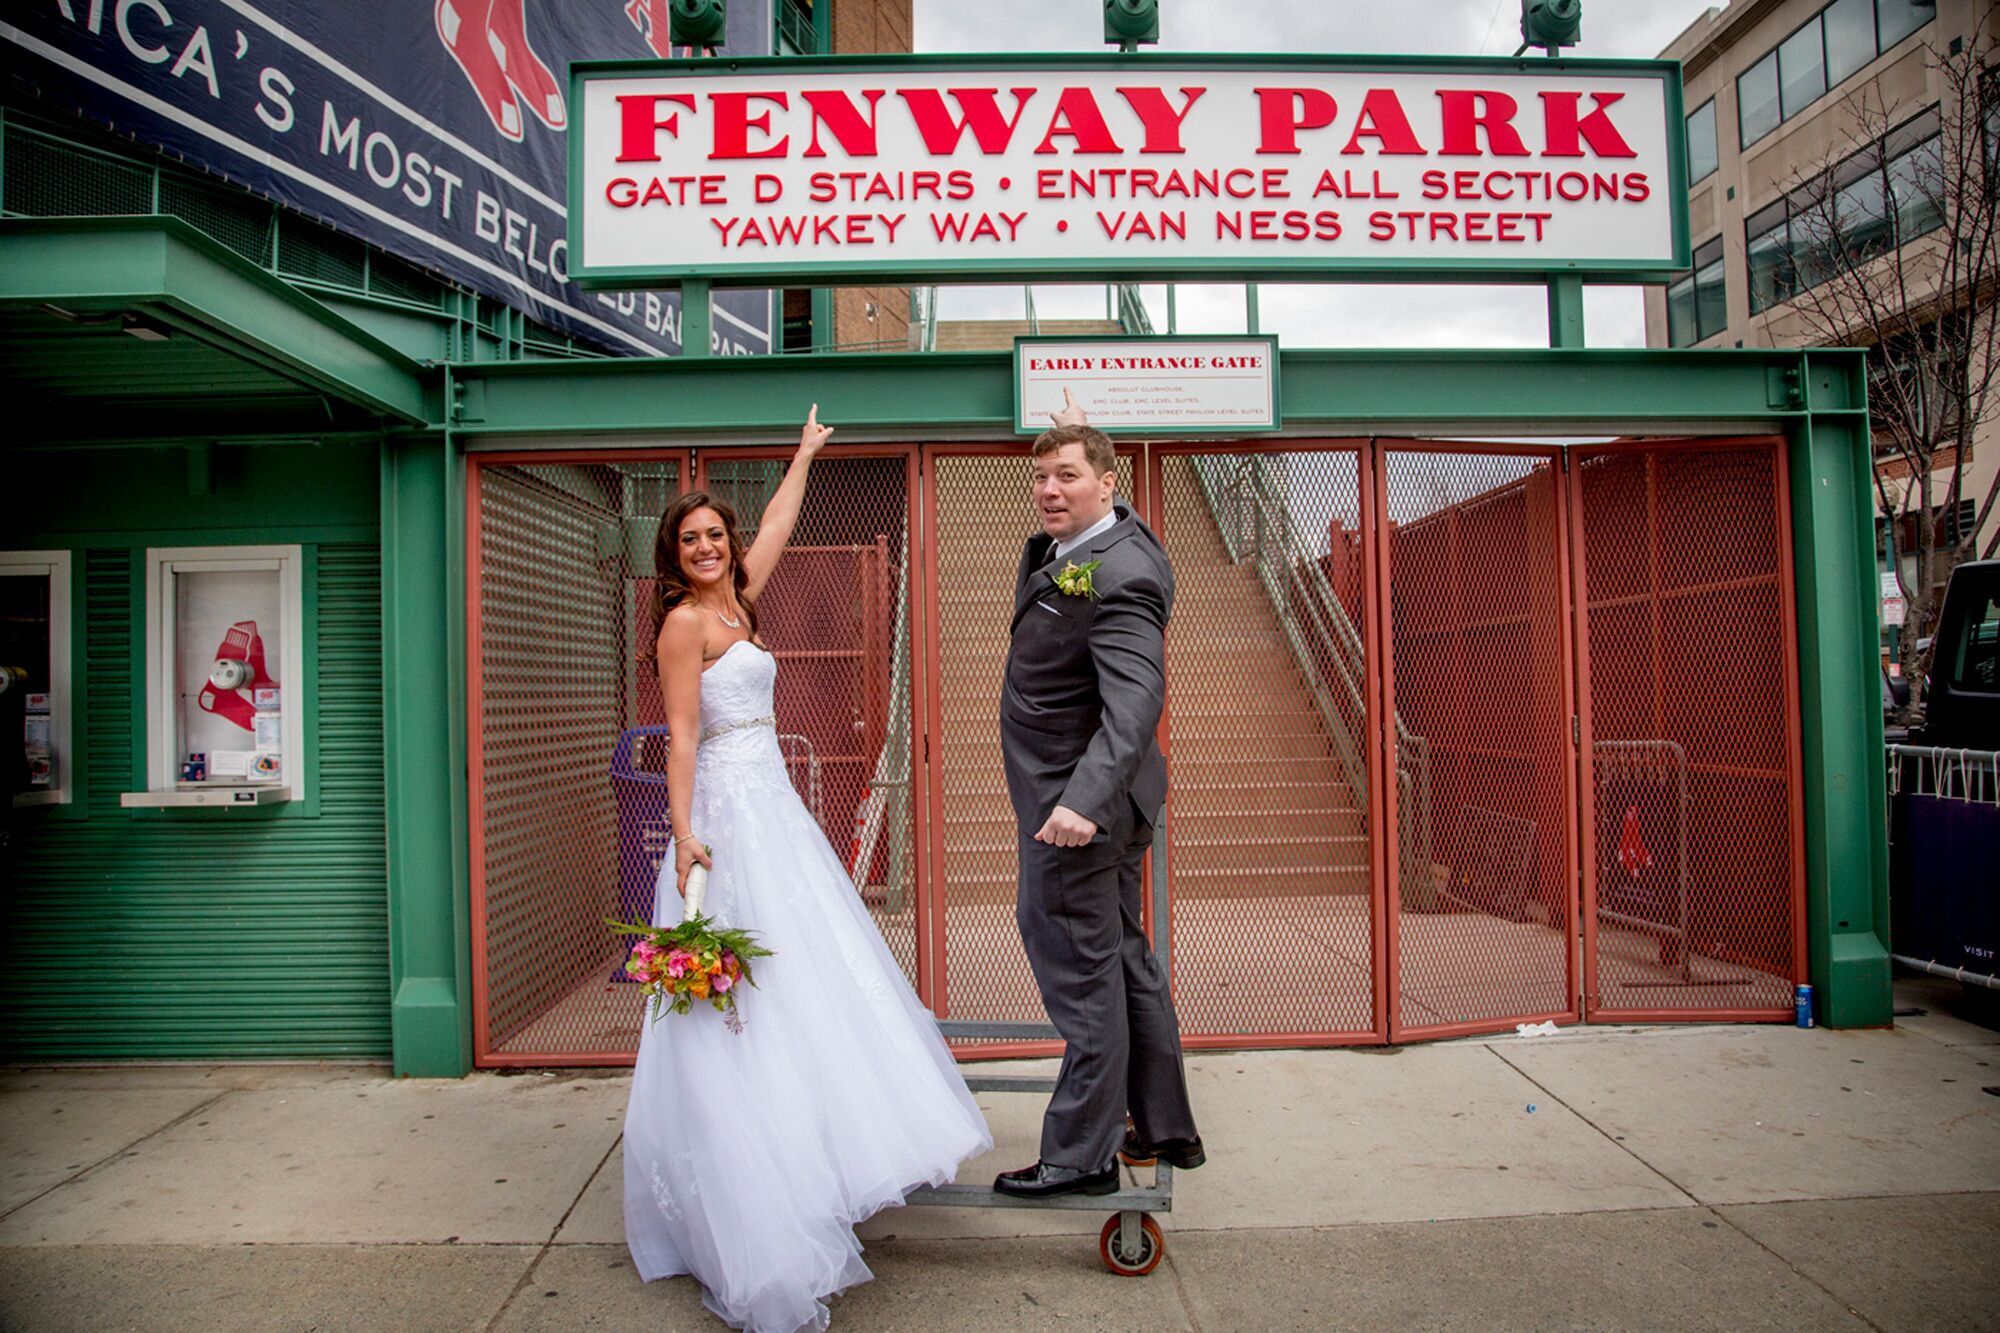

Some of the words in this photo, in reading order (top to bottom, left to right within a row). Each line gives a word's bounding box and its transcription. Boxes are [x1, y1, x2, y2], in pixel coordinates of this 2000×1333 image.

[616, 86, 1207, 162] FENWAY
[1253, 86, 1639, 159] PARK
[319, 100, 462, 220] MOST
[605, 174, 728, 208] GATE
[755, 173, 783, 203] D
[810, 170, 975, 203] STAIRS
[1037, 167, 1291, 199] ENTRANCE
[1312, 168, 1400, 199] ALL
[1421, 169, 1651, 203] SECTIONS
[711, 213, 907, 247] YAWKEY
[930, 211, 1028, 242] WAY
[1096, 210, 1187, 241] VAN
[1215, 209, 1343, 241] NESS
[1368, 210, 1553, 242] STREET
[1030, 358, 1095, 371] EARLY
[1100, 356, 1206, 370] ENTRANCE
[1210, 356, 1262, 369] GATE
[1964, 945, 1994, 958] VISIT
